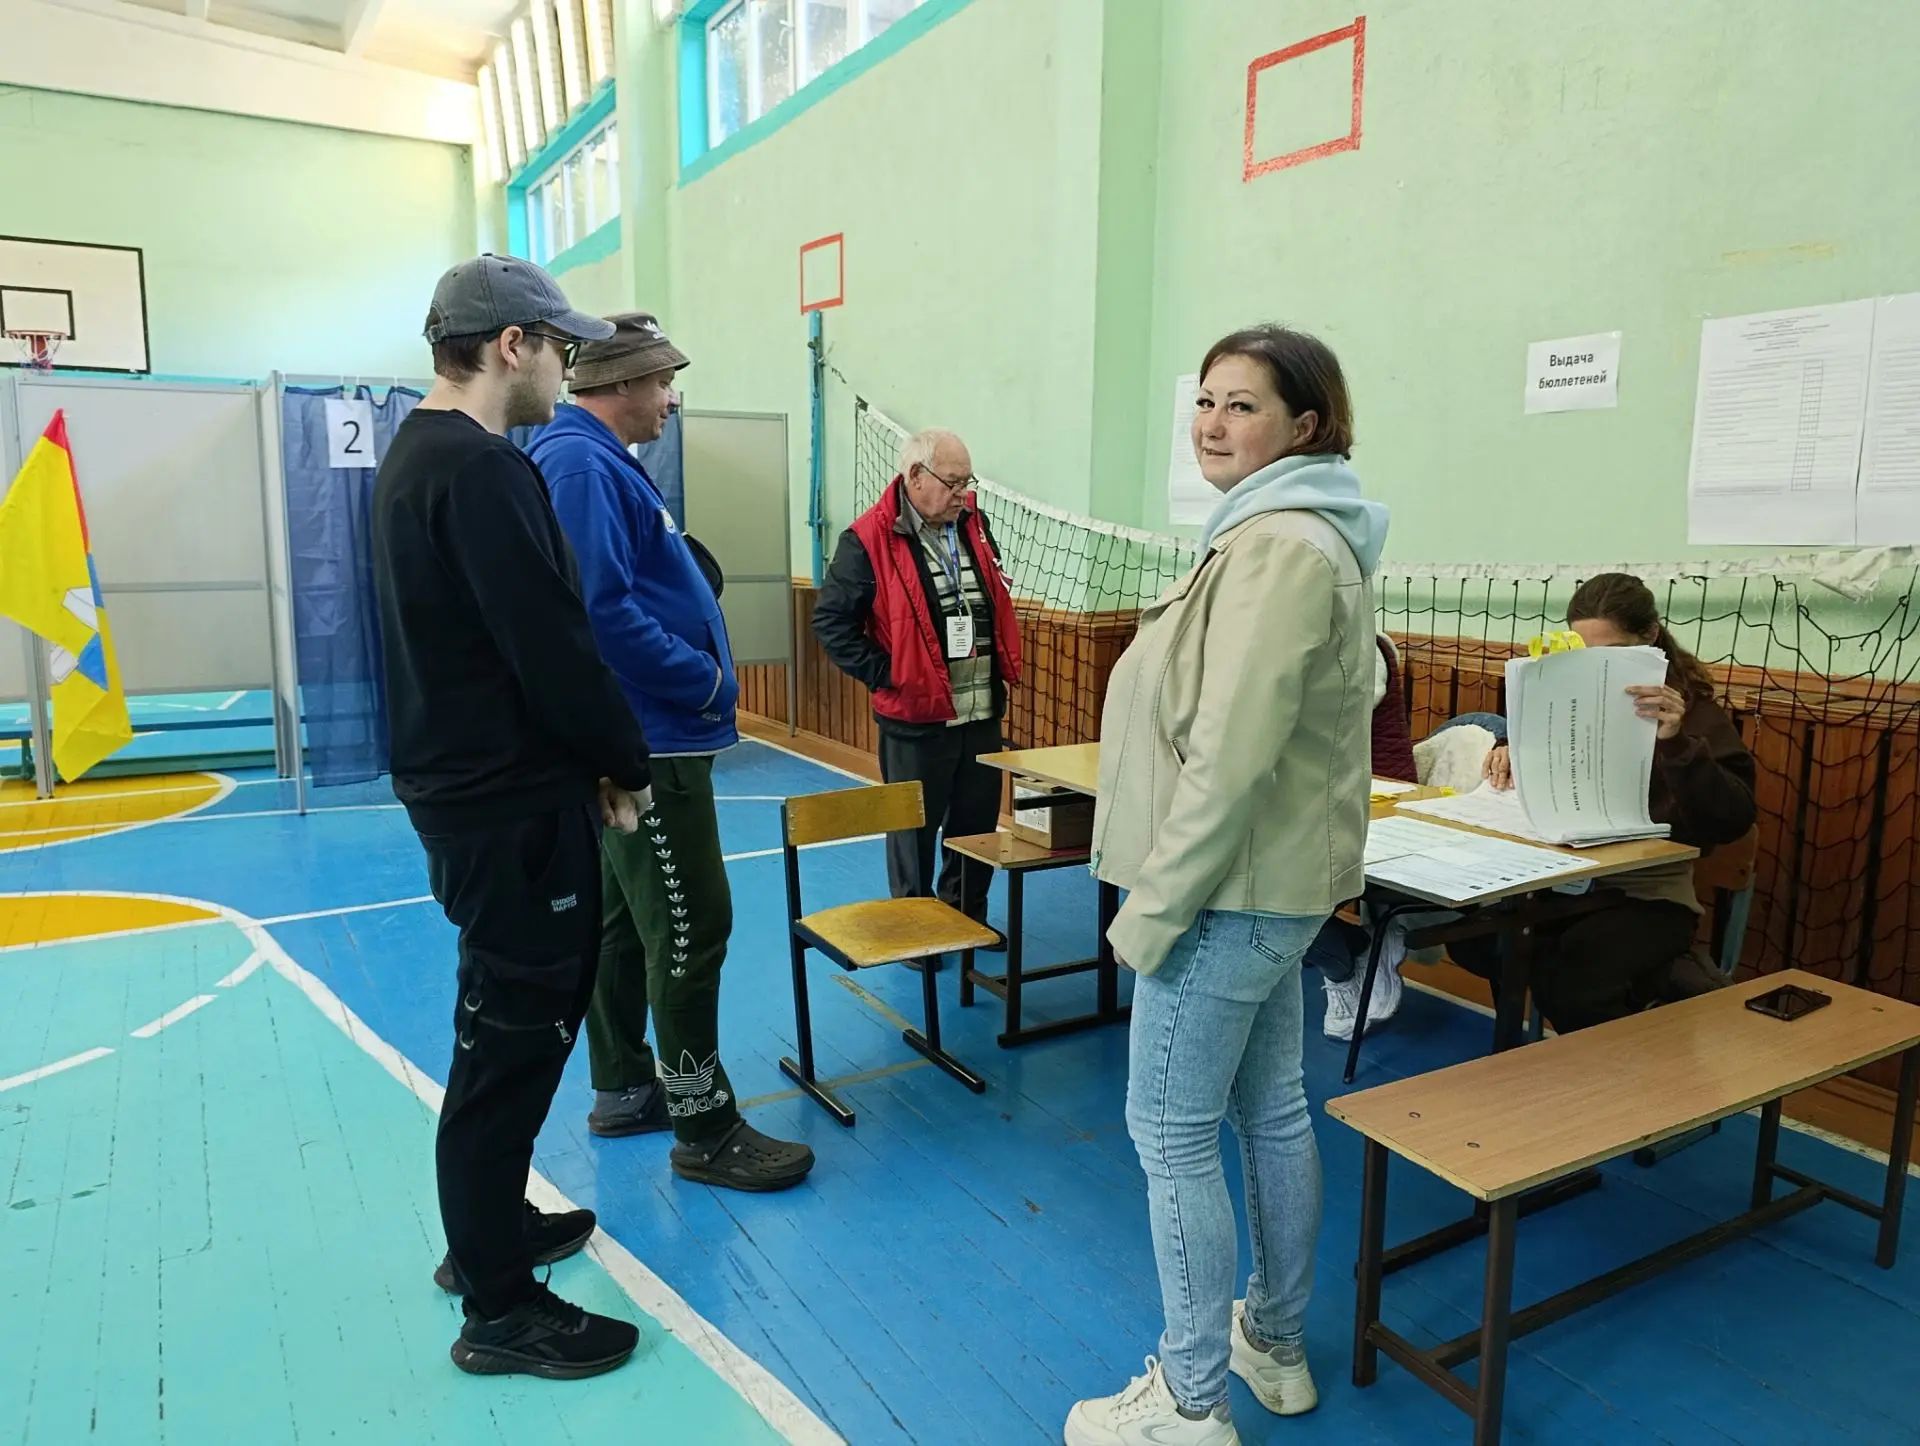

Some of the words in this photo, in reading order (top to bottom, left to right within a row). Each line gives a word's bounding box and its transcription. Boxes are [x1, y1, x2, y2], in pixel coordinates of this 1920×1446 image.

[1549, 353, 1594, 367] Выдача
[1538, 369, 1607, 389] бюллетеней
[342, 420, 363, 453] 2
[667, 1090, 729, 1117] adidas
